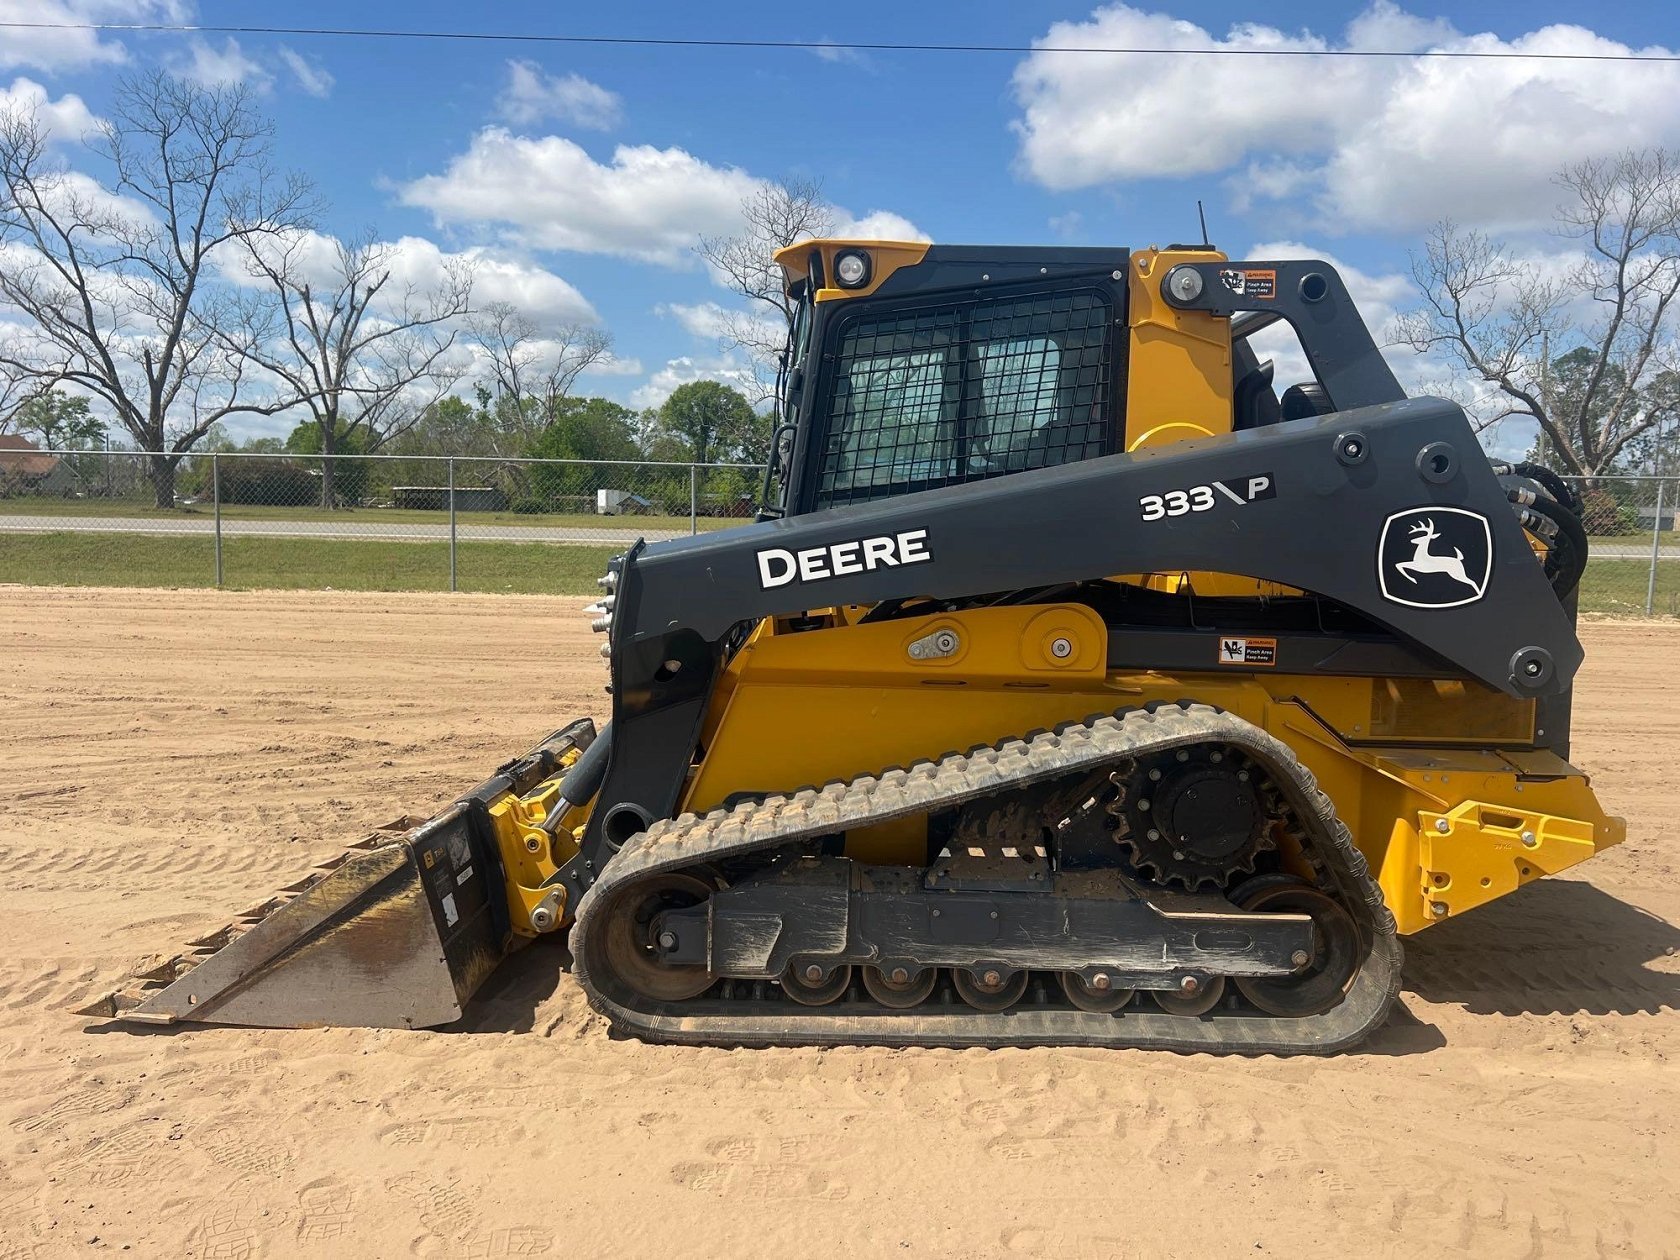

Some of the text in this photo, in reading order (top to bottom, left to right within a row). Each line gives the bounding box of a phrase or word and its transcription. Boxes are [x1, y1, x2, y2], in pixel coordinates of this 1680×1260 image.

[1140, 476, 1270, 521] 333 P
[757, 529, 930, 588] DEERE
